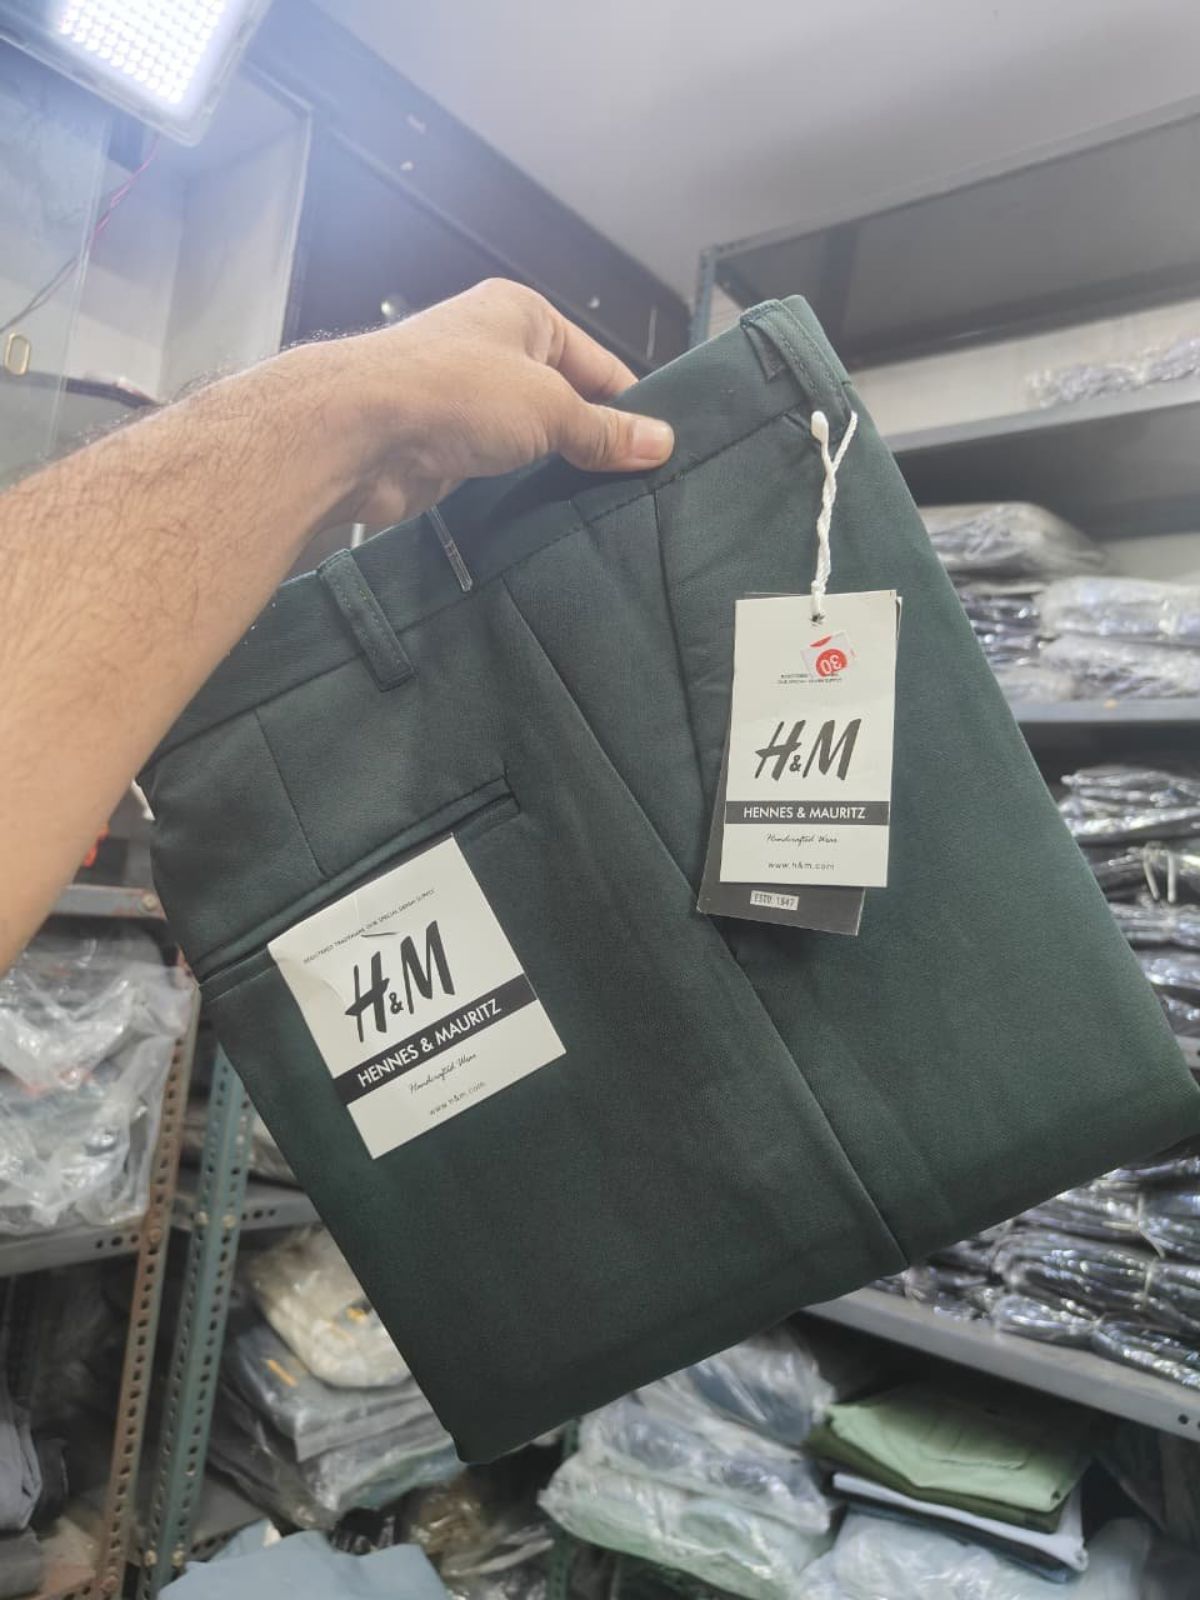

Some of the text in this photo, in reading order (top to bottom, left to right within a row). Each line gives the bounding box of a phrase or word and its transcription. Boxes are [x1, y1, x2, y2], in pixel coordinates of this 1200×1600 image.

[821, 654, 842, 675] 30
[754, 718, 862, 781] H&M
[743, 806, 866, 820] HENNES & MAURITZ
[344, 920, 456, 1043] H&M
[356, 997, 503, 1089] HENNES & MAURITZ
